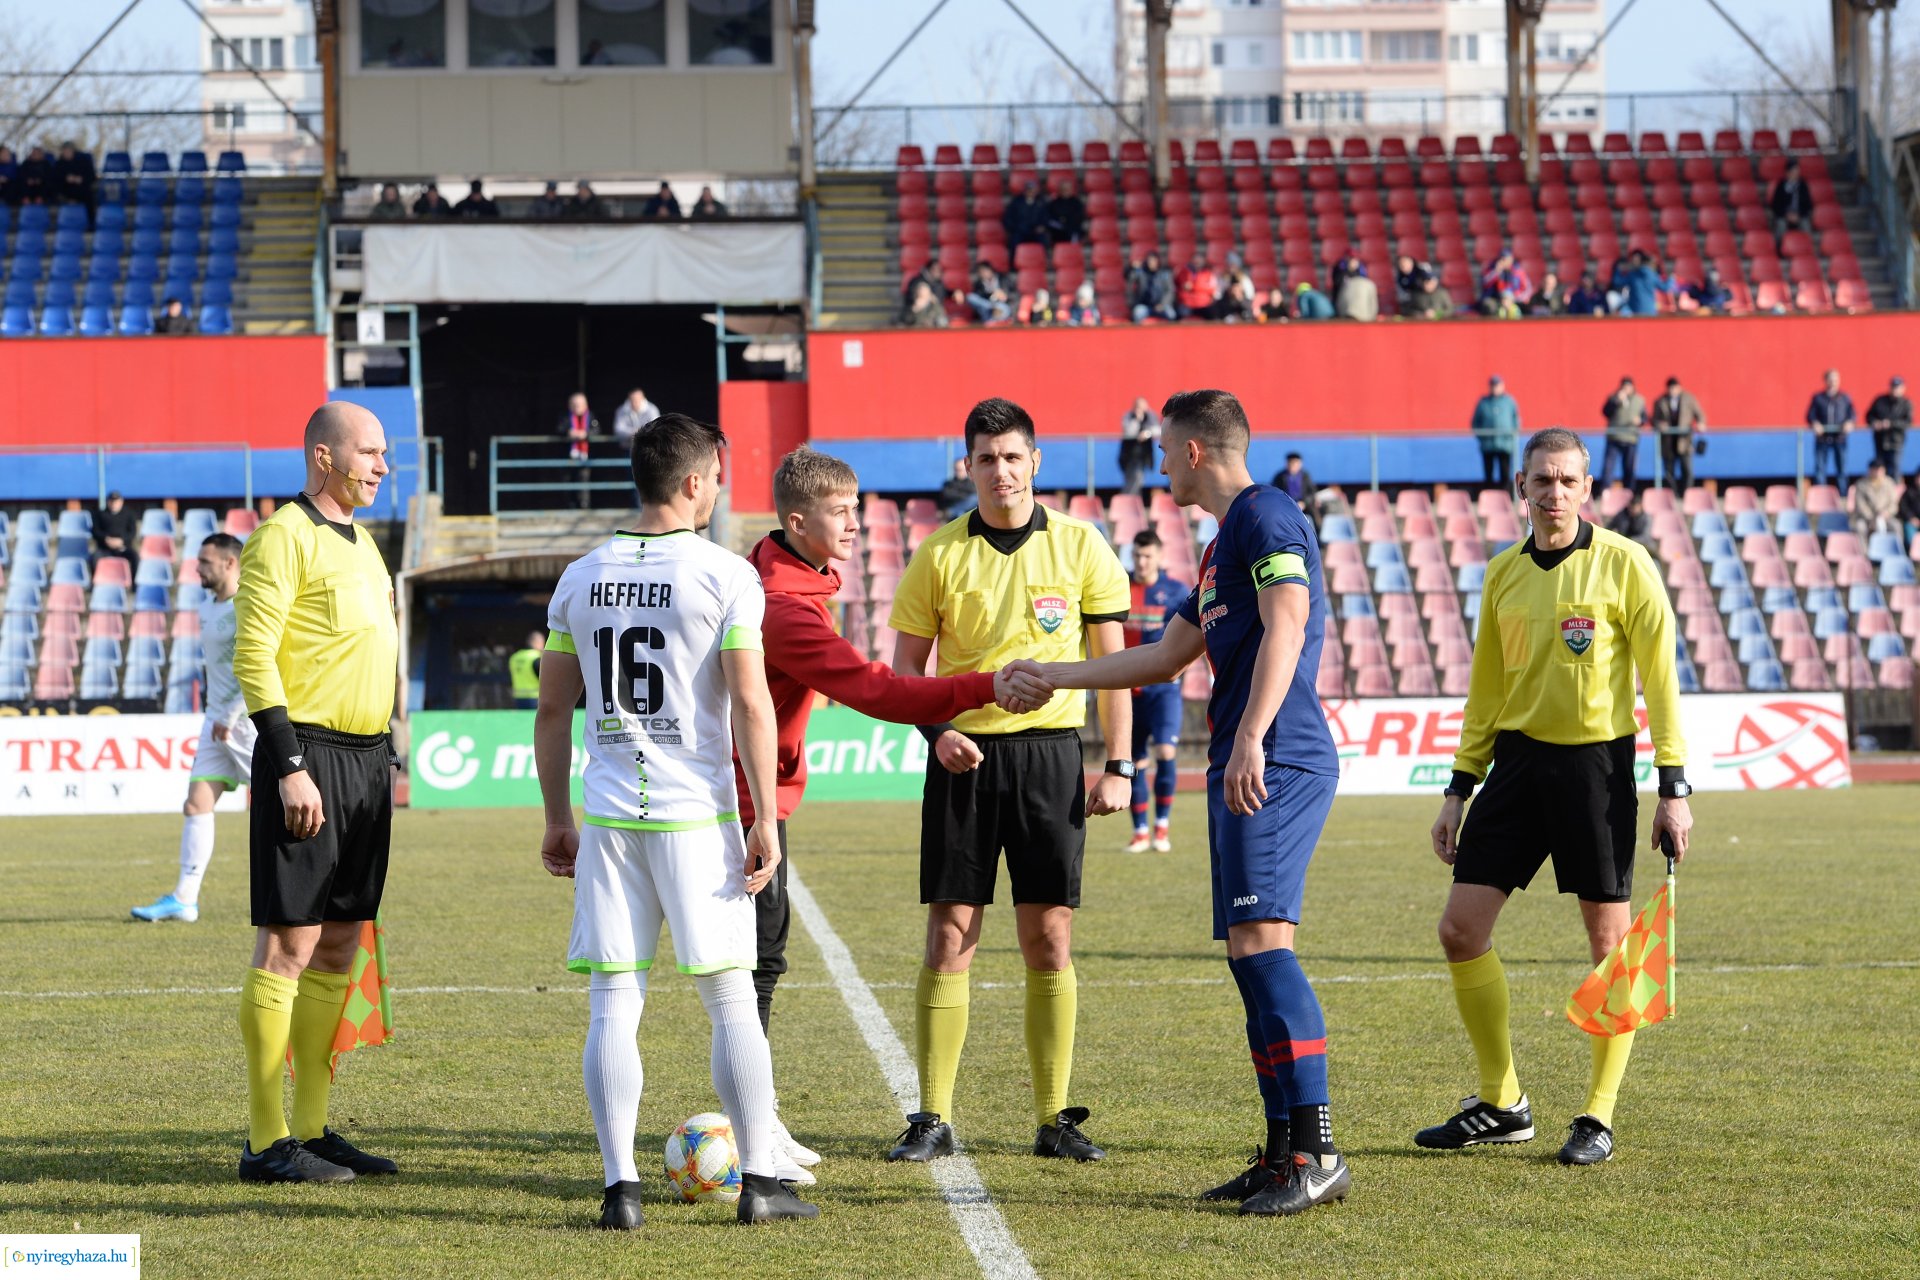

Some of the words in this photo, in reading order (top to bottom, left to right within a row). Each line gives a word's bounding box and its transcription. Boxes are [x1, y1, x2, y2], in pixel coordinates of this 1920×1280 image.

[1255, 560, 1275, 585] C
[590, 582, 672, 608] HEFFLER
[594, 626, 665, 715] 16
[596, 717, 680, 731] KONTEX
[1233, 895, 1259, 907] JAKO
